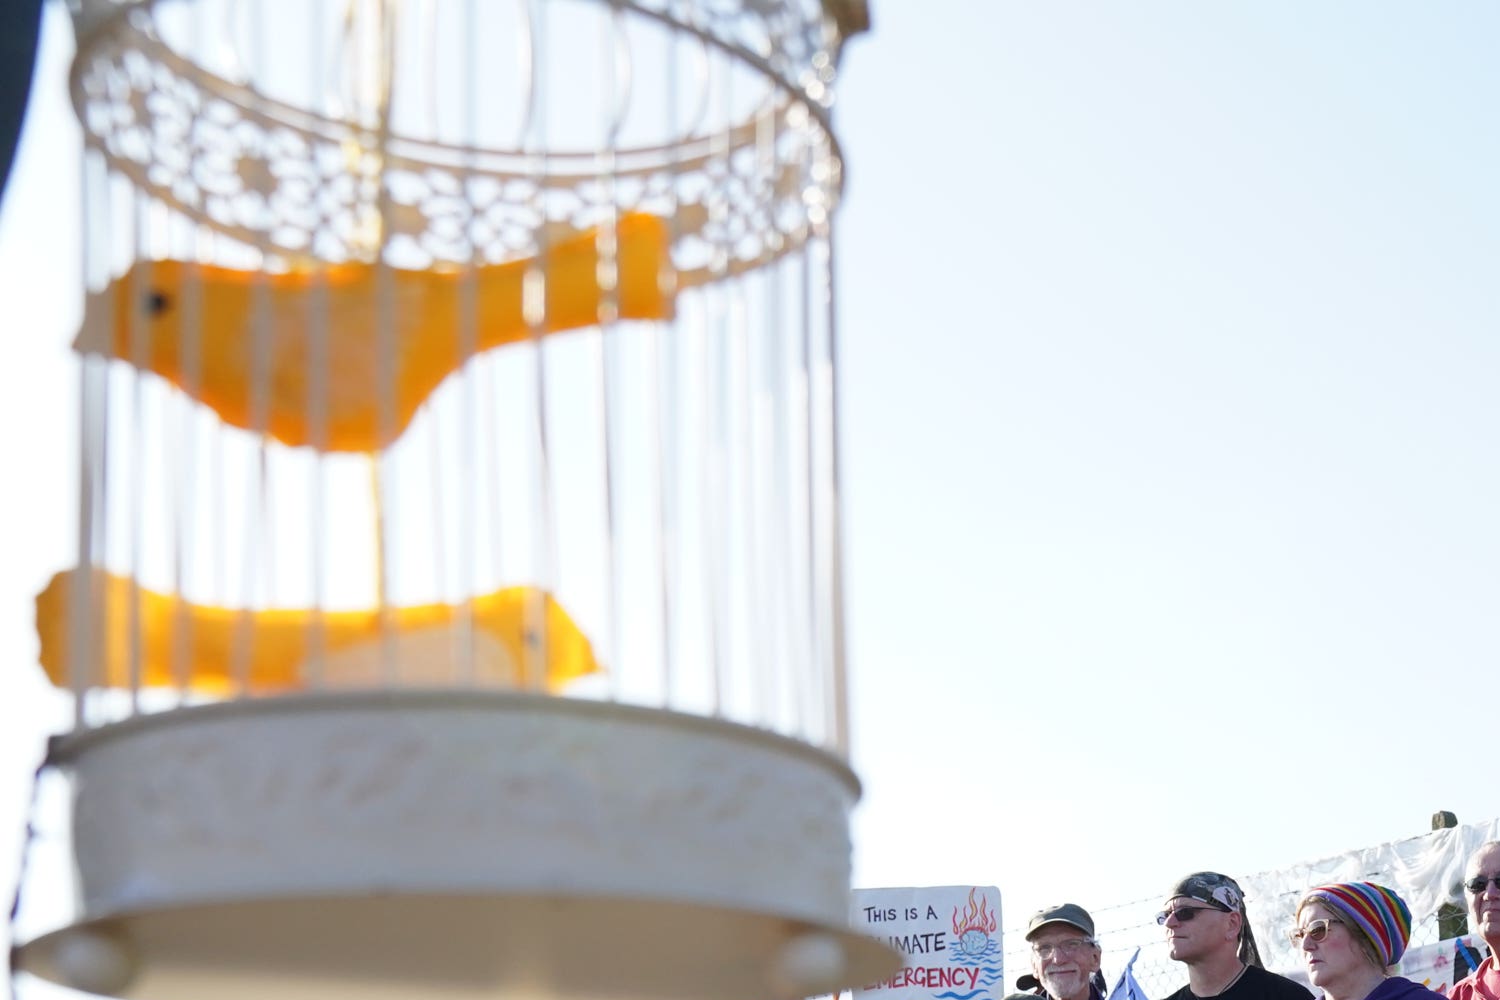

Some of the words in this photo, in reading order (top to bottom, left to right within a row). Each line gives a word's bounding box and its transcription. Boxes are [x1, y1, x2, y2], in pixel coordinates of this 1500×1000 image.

[864, 905, 897, 922] THIS
[905, 907, 918, 921] IS
[926, 905, 938, 920] A
[869, 932, 946, 954] IMATE
